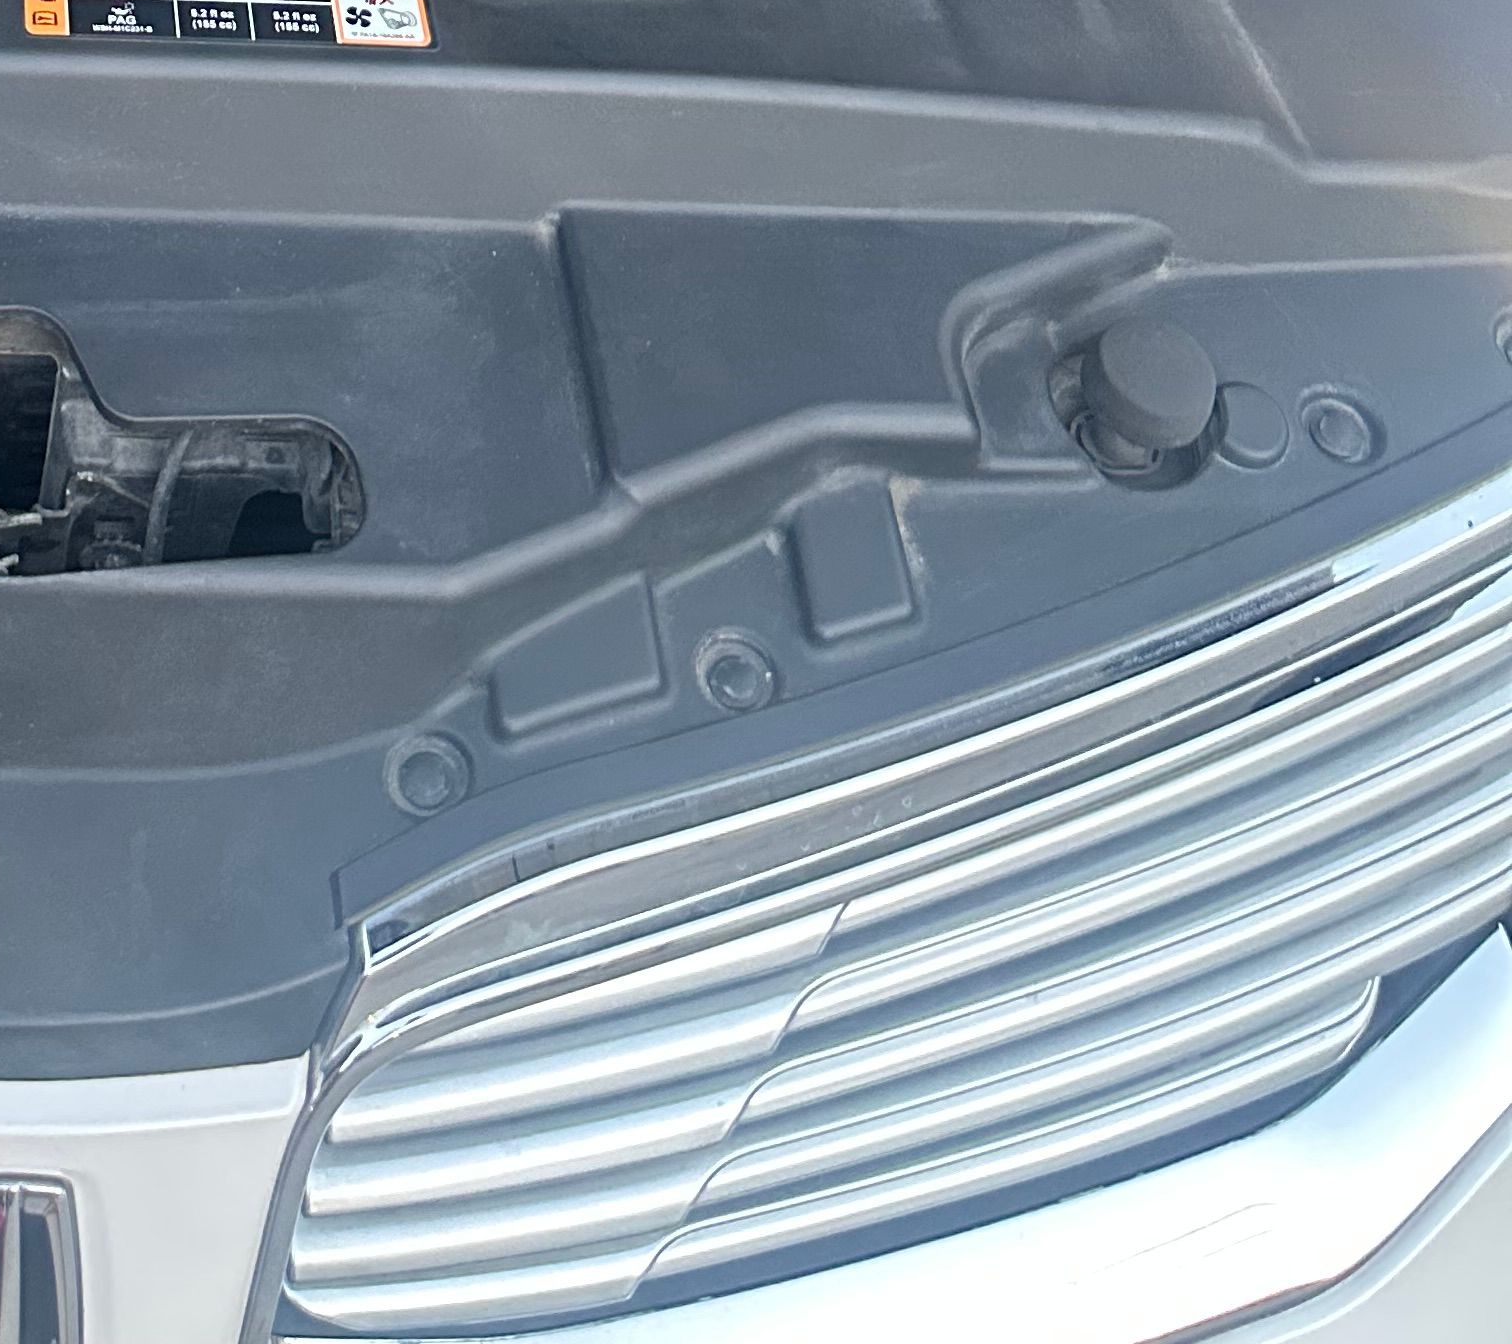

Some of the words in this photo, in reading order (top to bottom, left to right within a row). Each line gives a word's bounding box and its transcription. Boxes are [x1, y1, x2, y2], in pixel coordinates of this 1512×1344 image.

[107, 14, 137, 25] PAG
[220, 11, 235, 19] oz
[302, 13, 317, 22] oz
